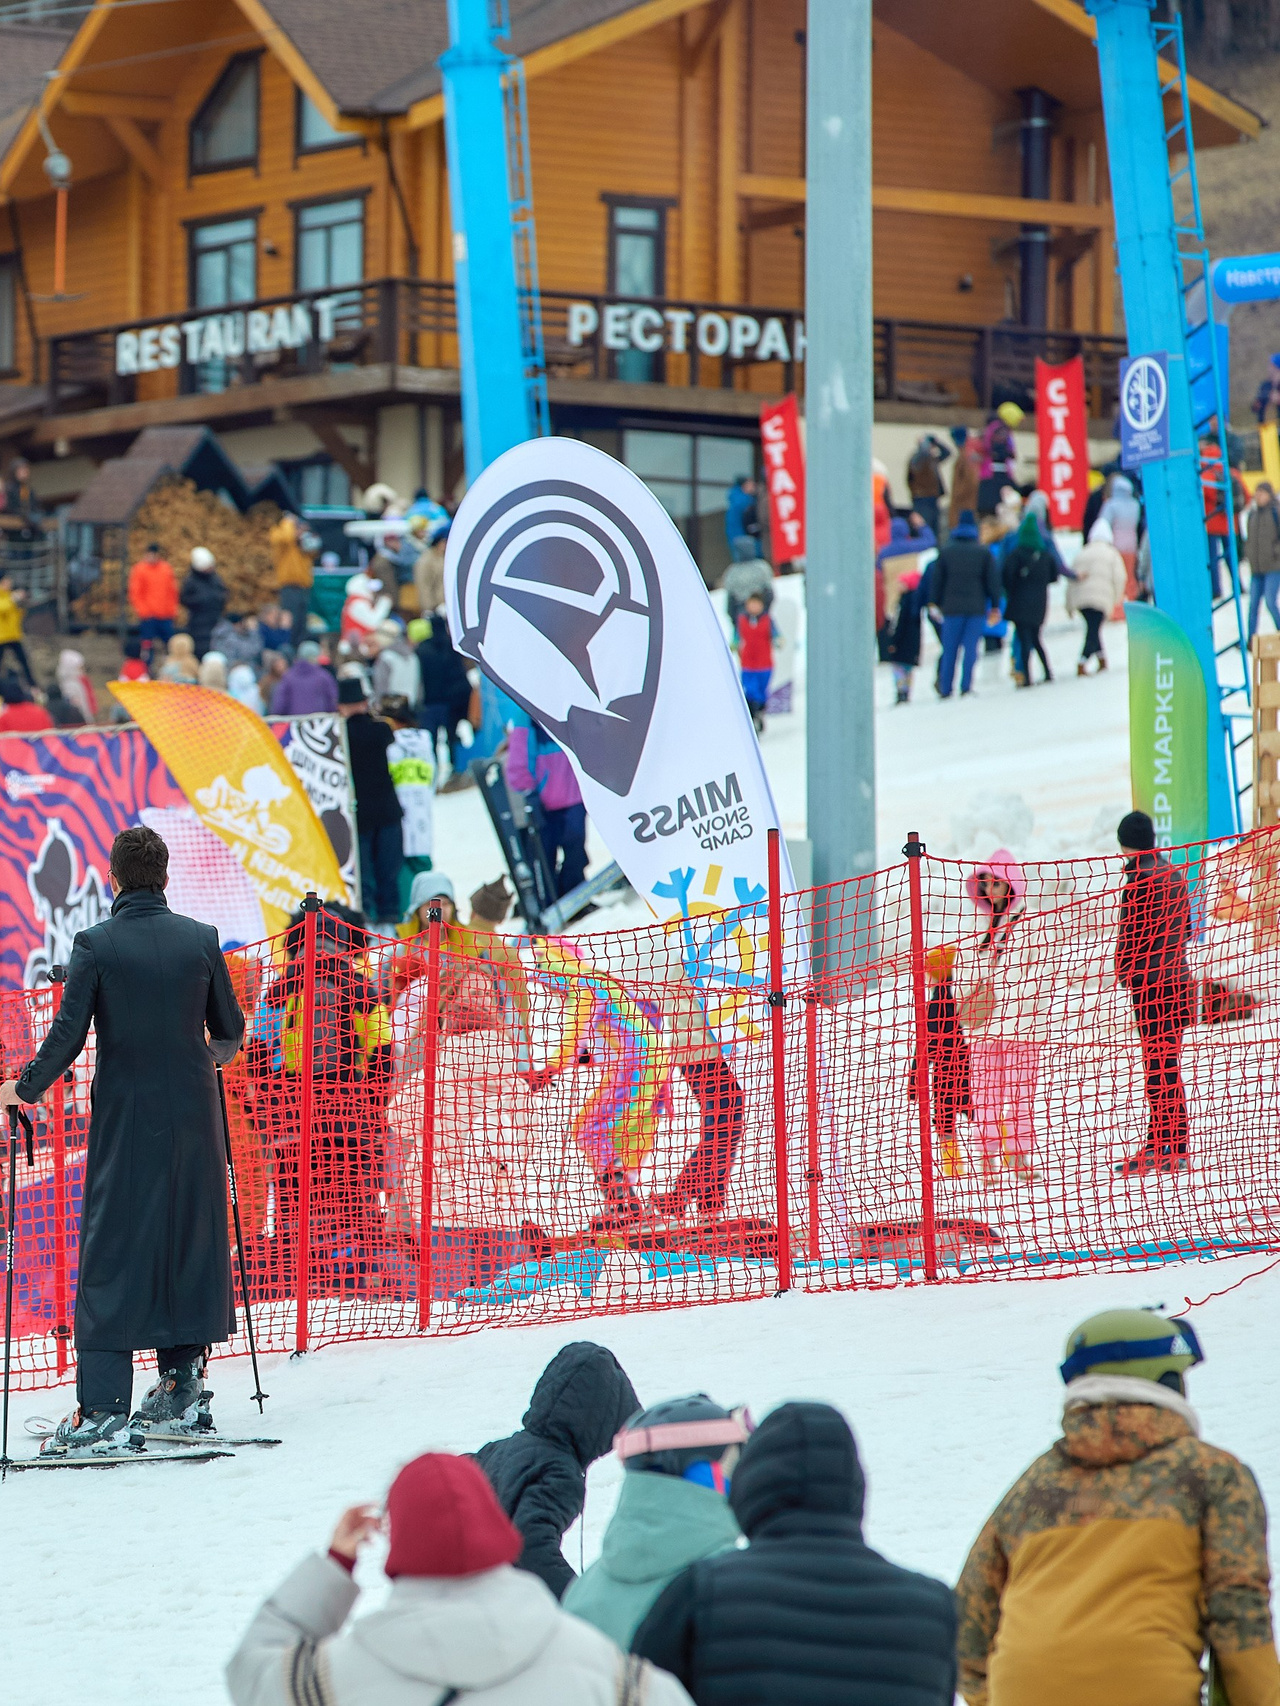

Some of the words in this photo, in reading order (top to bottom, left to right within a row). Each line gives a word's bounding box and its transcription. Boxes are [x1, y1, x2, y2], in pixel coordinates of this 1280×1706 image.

[116, 299, 338, 377] RESTAURANT
[761, 414, 801, 546] СТАРТ
[1046, 377, 1076, 516] СТАРТ
[1154, 652, 1174, 785] МАРКЕТ
